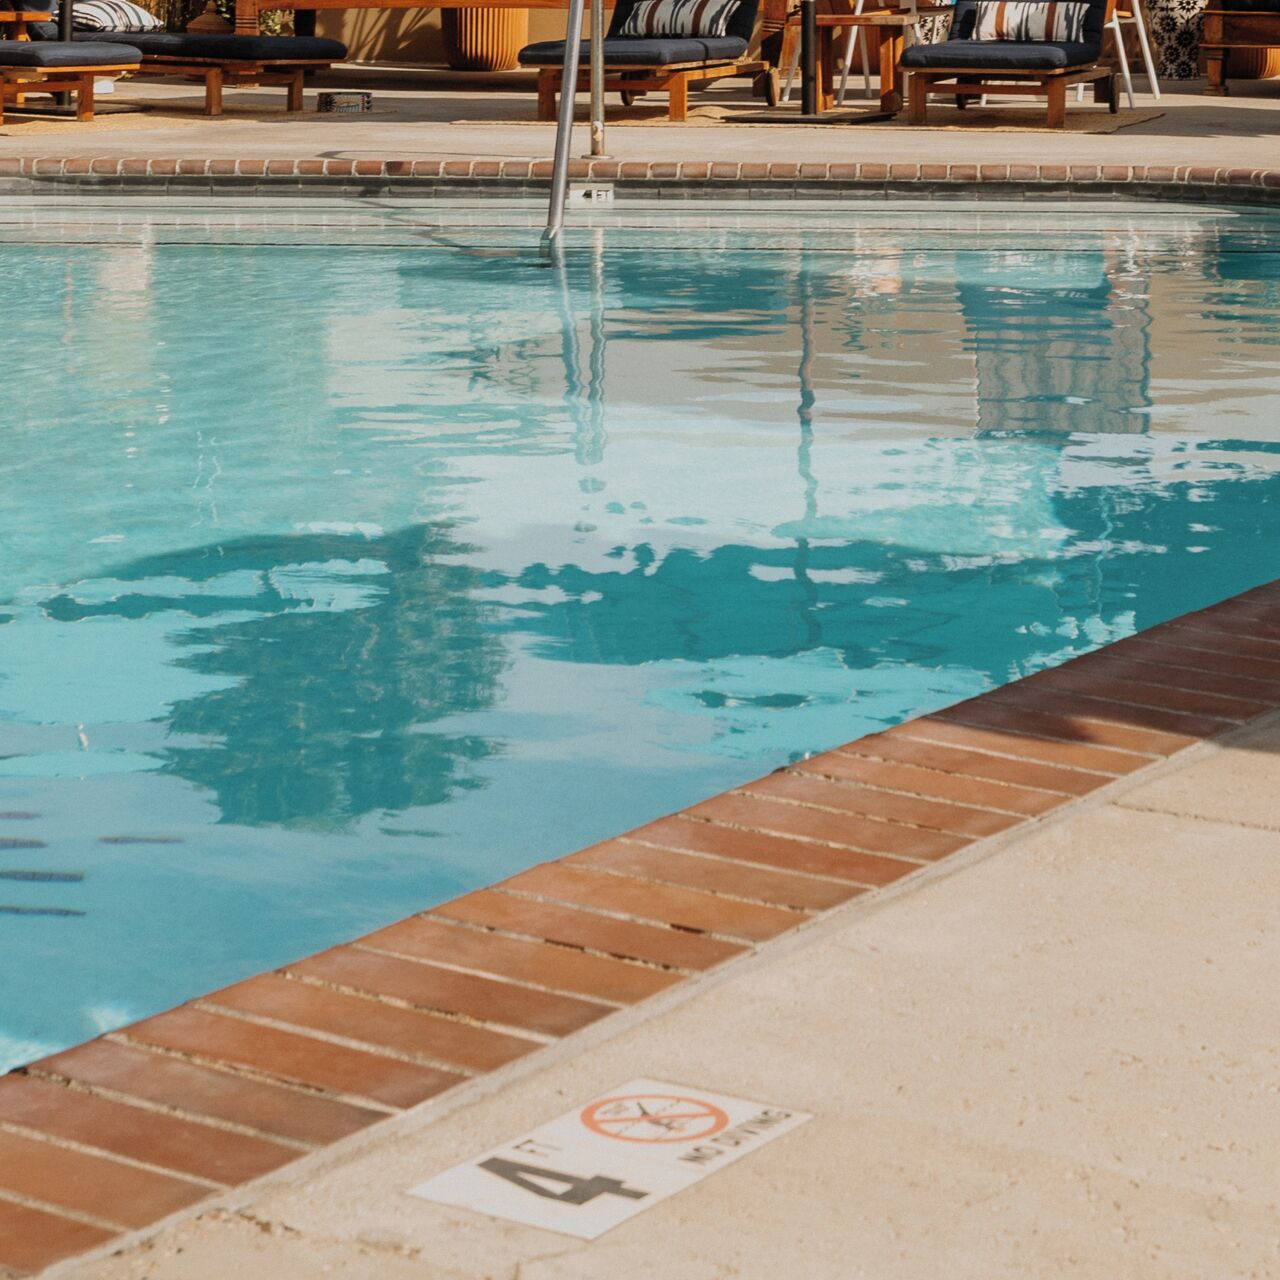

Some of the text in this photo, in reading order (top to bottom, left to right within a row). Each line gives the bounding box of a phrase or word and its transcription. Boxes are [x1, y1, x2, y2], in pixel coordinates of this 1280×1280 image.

[512, 1138, 564, 1158] FT
[677, 1108, 792, 1165] NO DIVING
[477, 1156, 651, 1206] 4
